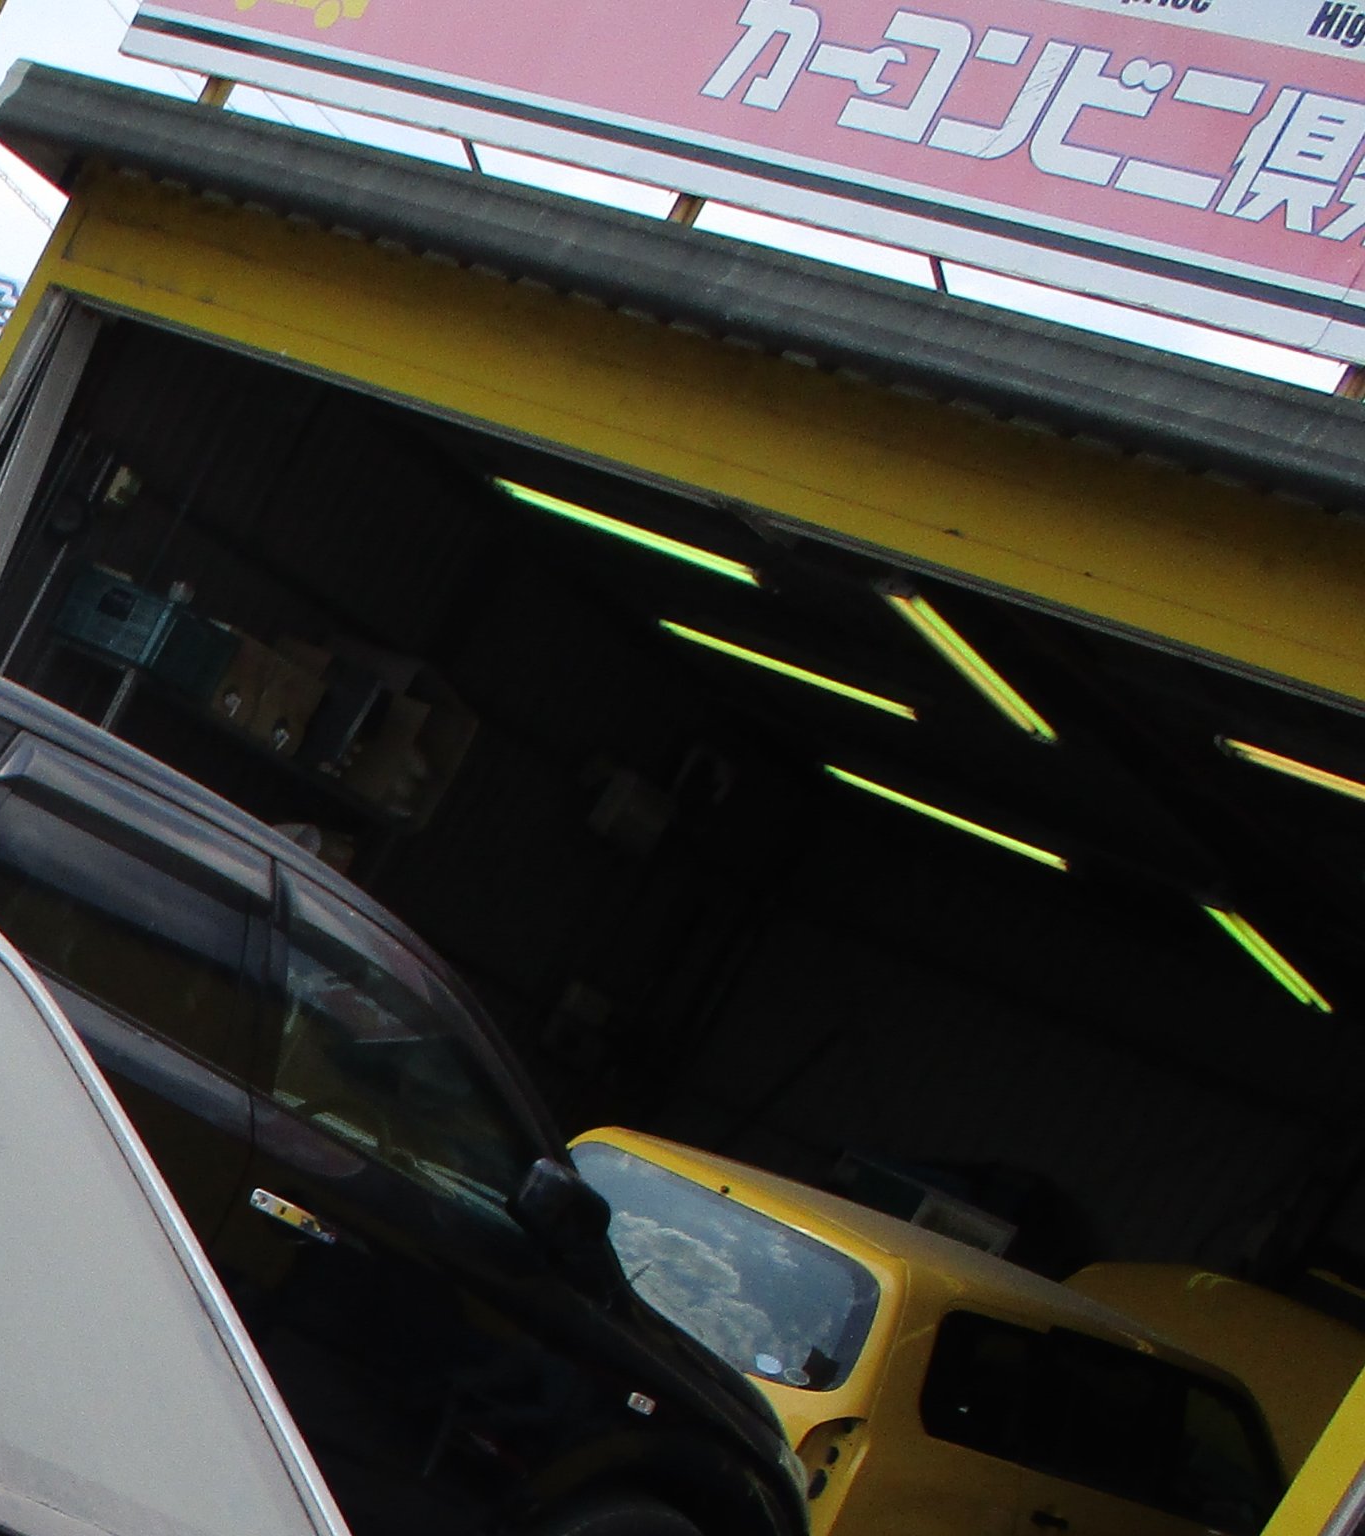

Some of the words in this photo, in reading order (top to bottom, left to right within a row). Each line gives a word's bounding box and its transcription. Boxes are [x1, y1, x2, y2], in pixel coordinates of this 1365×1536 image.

[699, 0, 1365, 243] カーコンビニ倶
